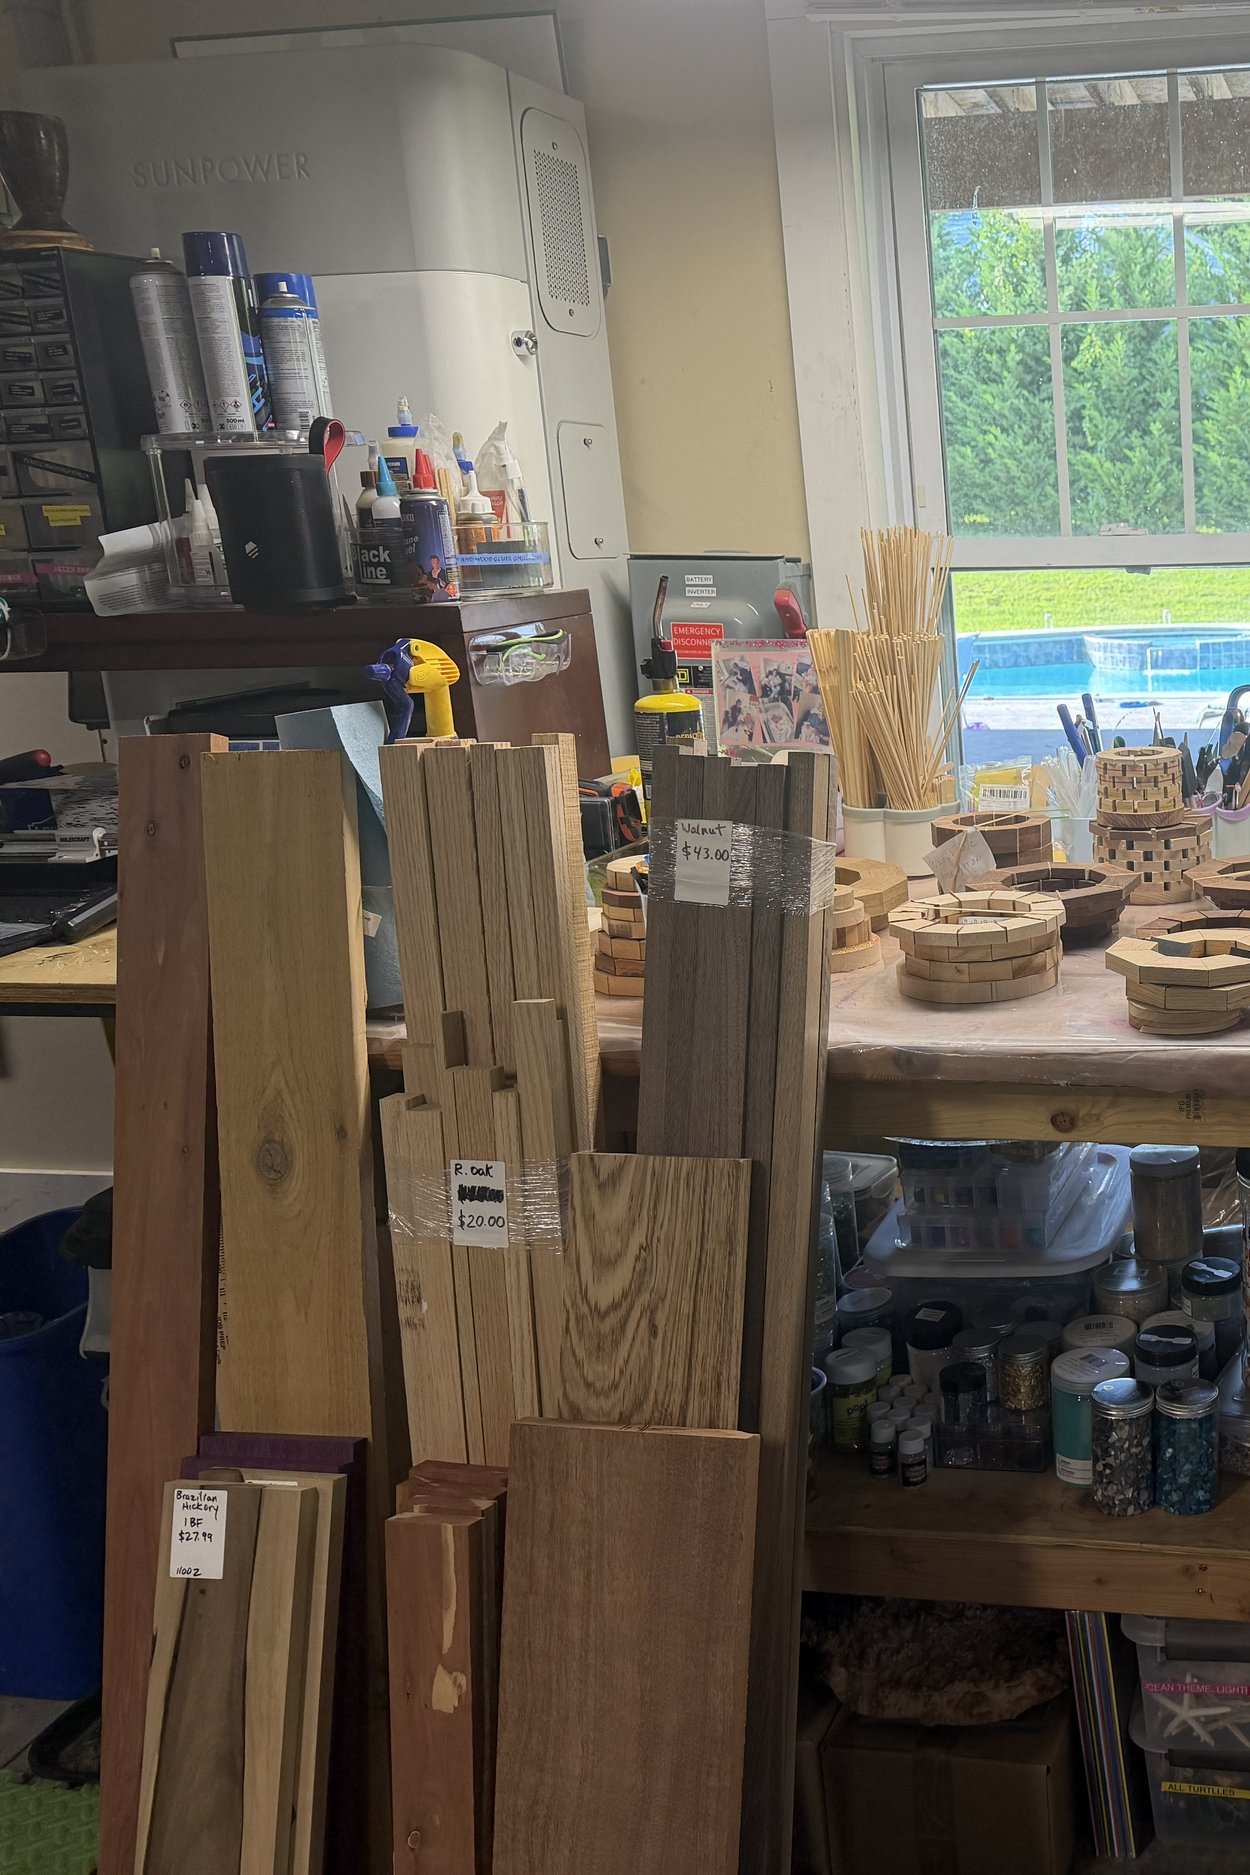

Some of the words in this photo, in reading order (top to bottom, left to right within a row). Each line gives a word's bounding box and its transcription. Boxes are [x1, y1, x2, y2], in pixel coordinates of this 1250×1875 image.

[132, 152, 310, 189] SUNPOWER
[674, 627, 720, 636] EMERGENCY
[673, 638, 713, 646] DISCONNE
[681, 823, 727, 836] Walnut
[681, 841, 729, 861] $43.00
[457, 1209, 505, 1231] $20.00
[176, 1490, 217, 1502] Brazilian
[182, 1502, 219, 1520] Hickory
[178, 1530, 213, 1543] $27.99
[1168, 1782, 1185, 1791] ALL
